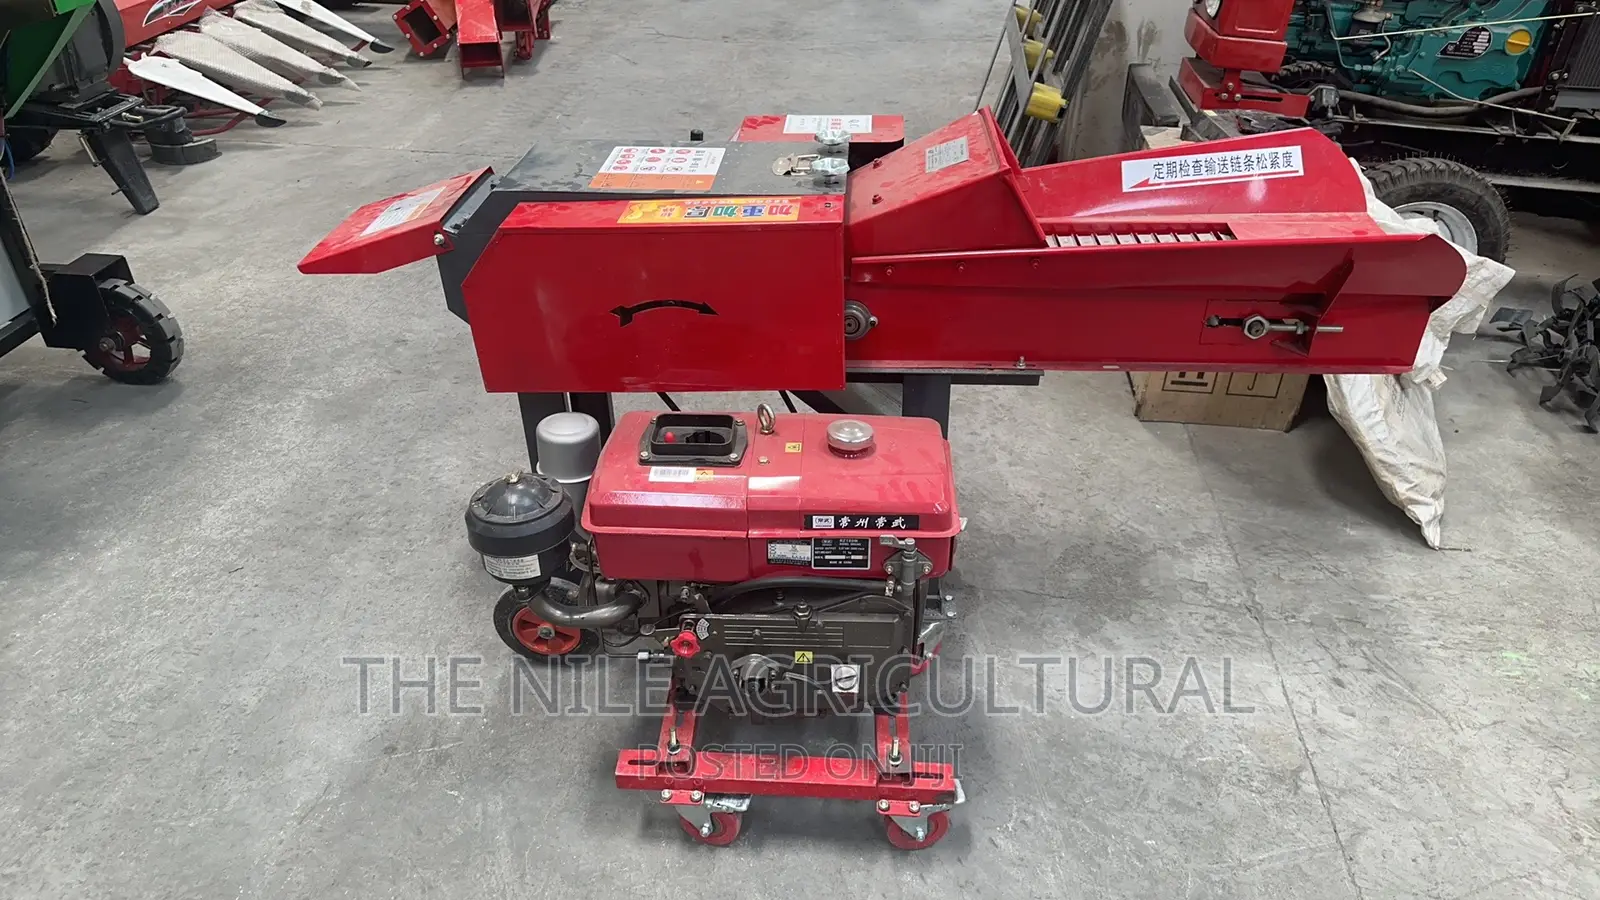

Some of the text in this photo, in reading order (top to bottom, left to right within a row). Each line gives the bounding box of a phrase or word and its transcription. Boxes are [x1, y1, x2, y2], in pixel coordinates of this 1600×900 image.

[1152, 151, 1294, 180] 定期检查输送链条松紧度
